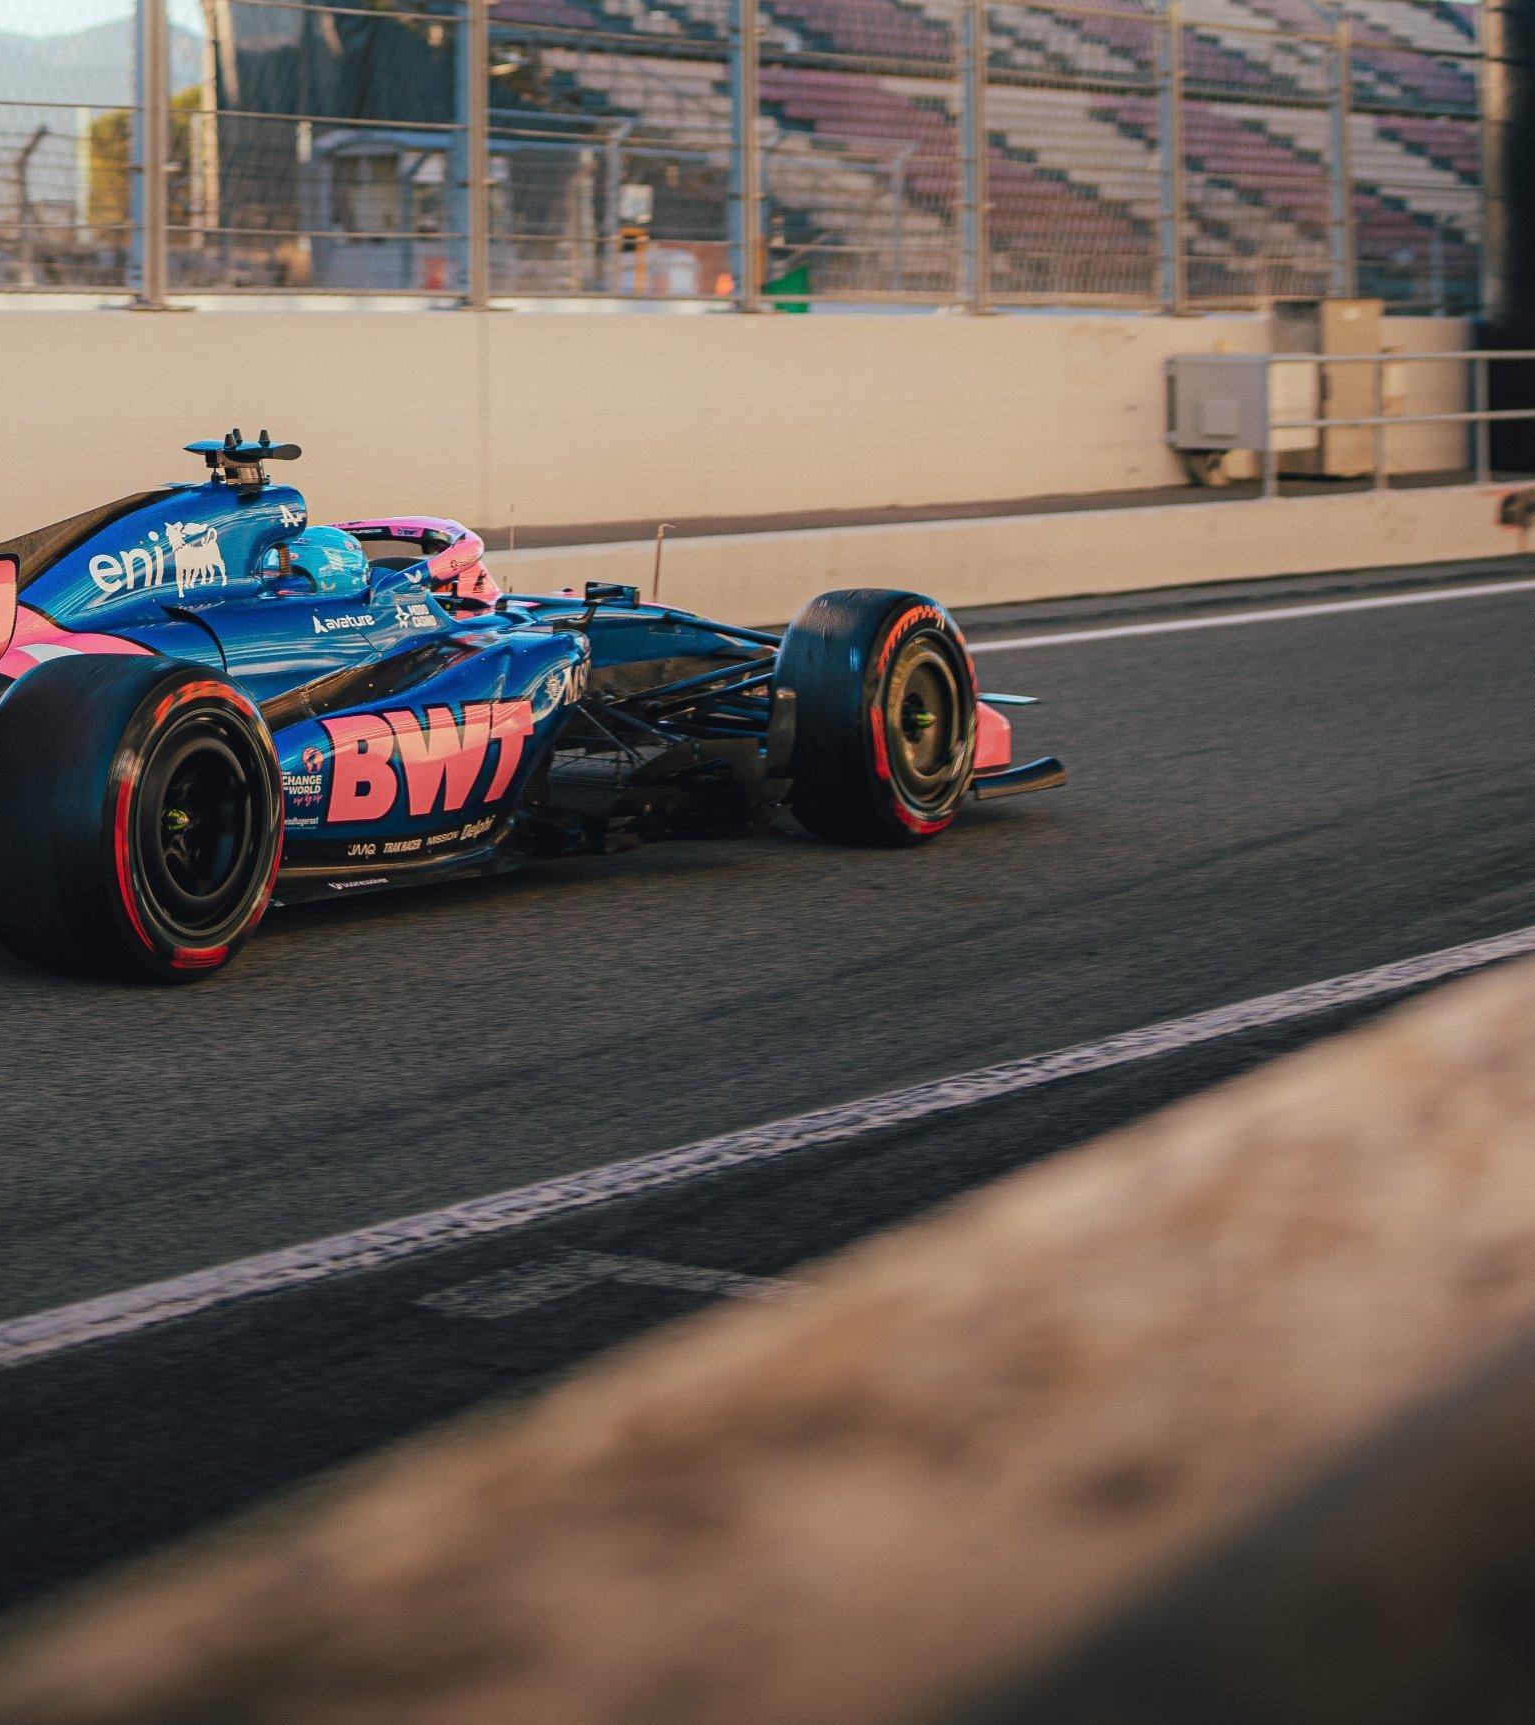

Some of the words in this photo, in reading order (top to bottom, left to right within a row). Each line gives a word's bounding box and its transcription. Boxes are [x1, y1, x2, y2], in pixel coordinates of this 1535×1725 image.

[89, 531, 164, 593] eni
[325, 615, 375, 629] avature
[321, 700, 535, 823] BWT
[282, 775, 322, 786] CHANGE
[289, 785, 321, 795] WORLD
